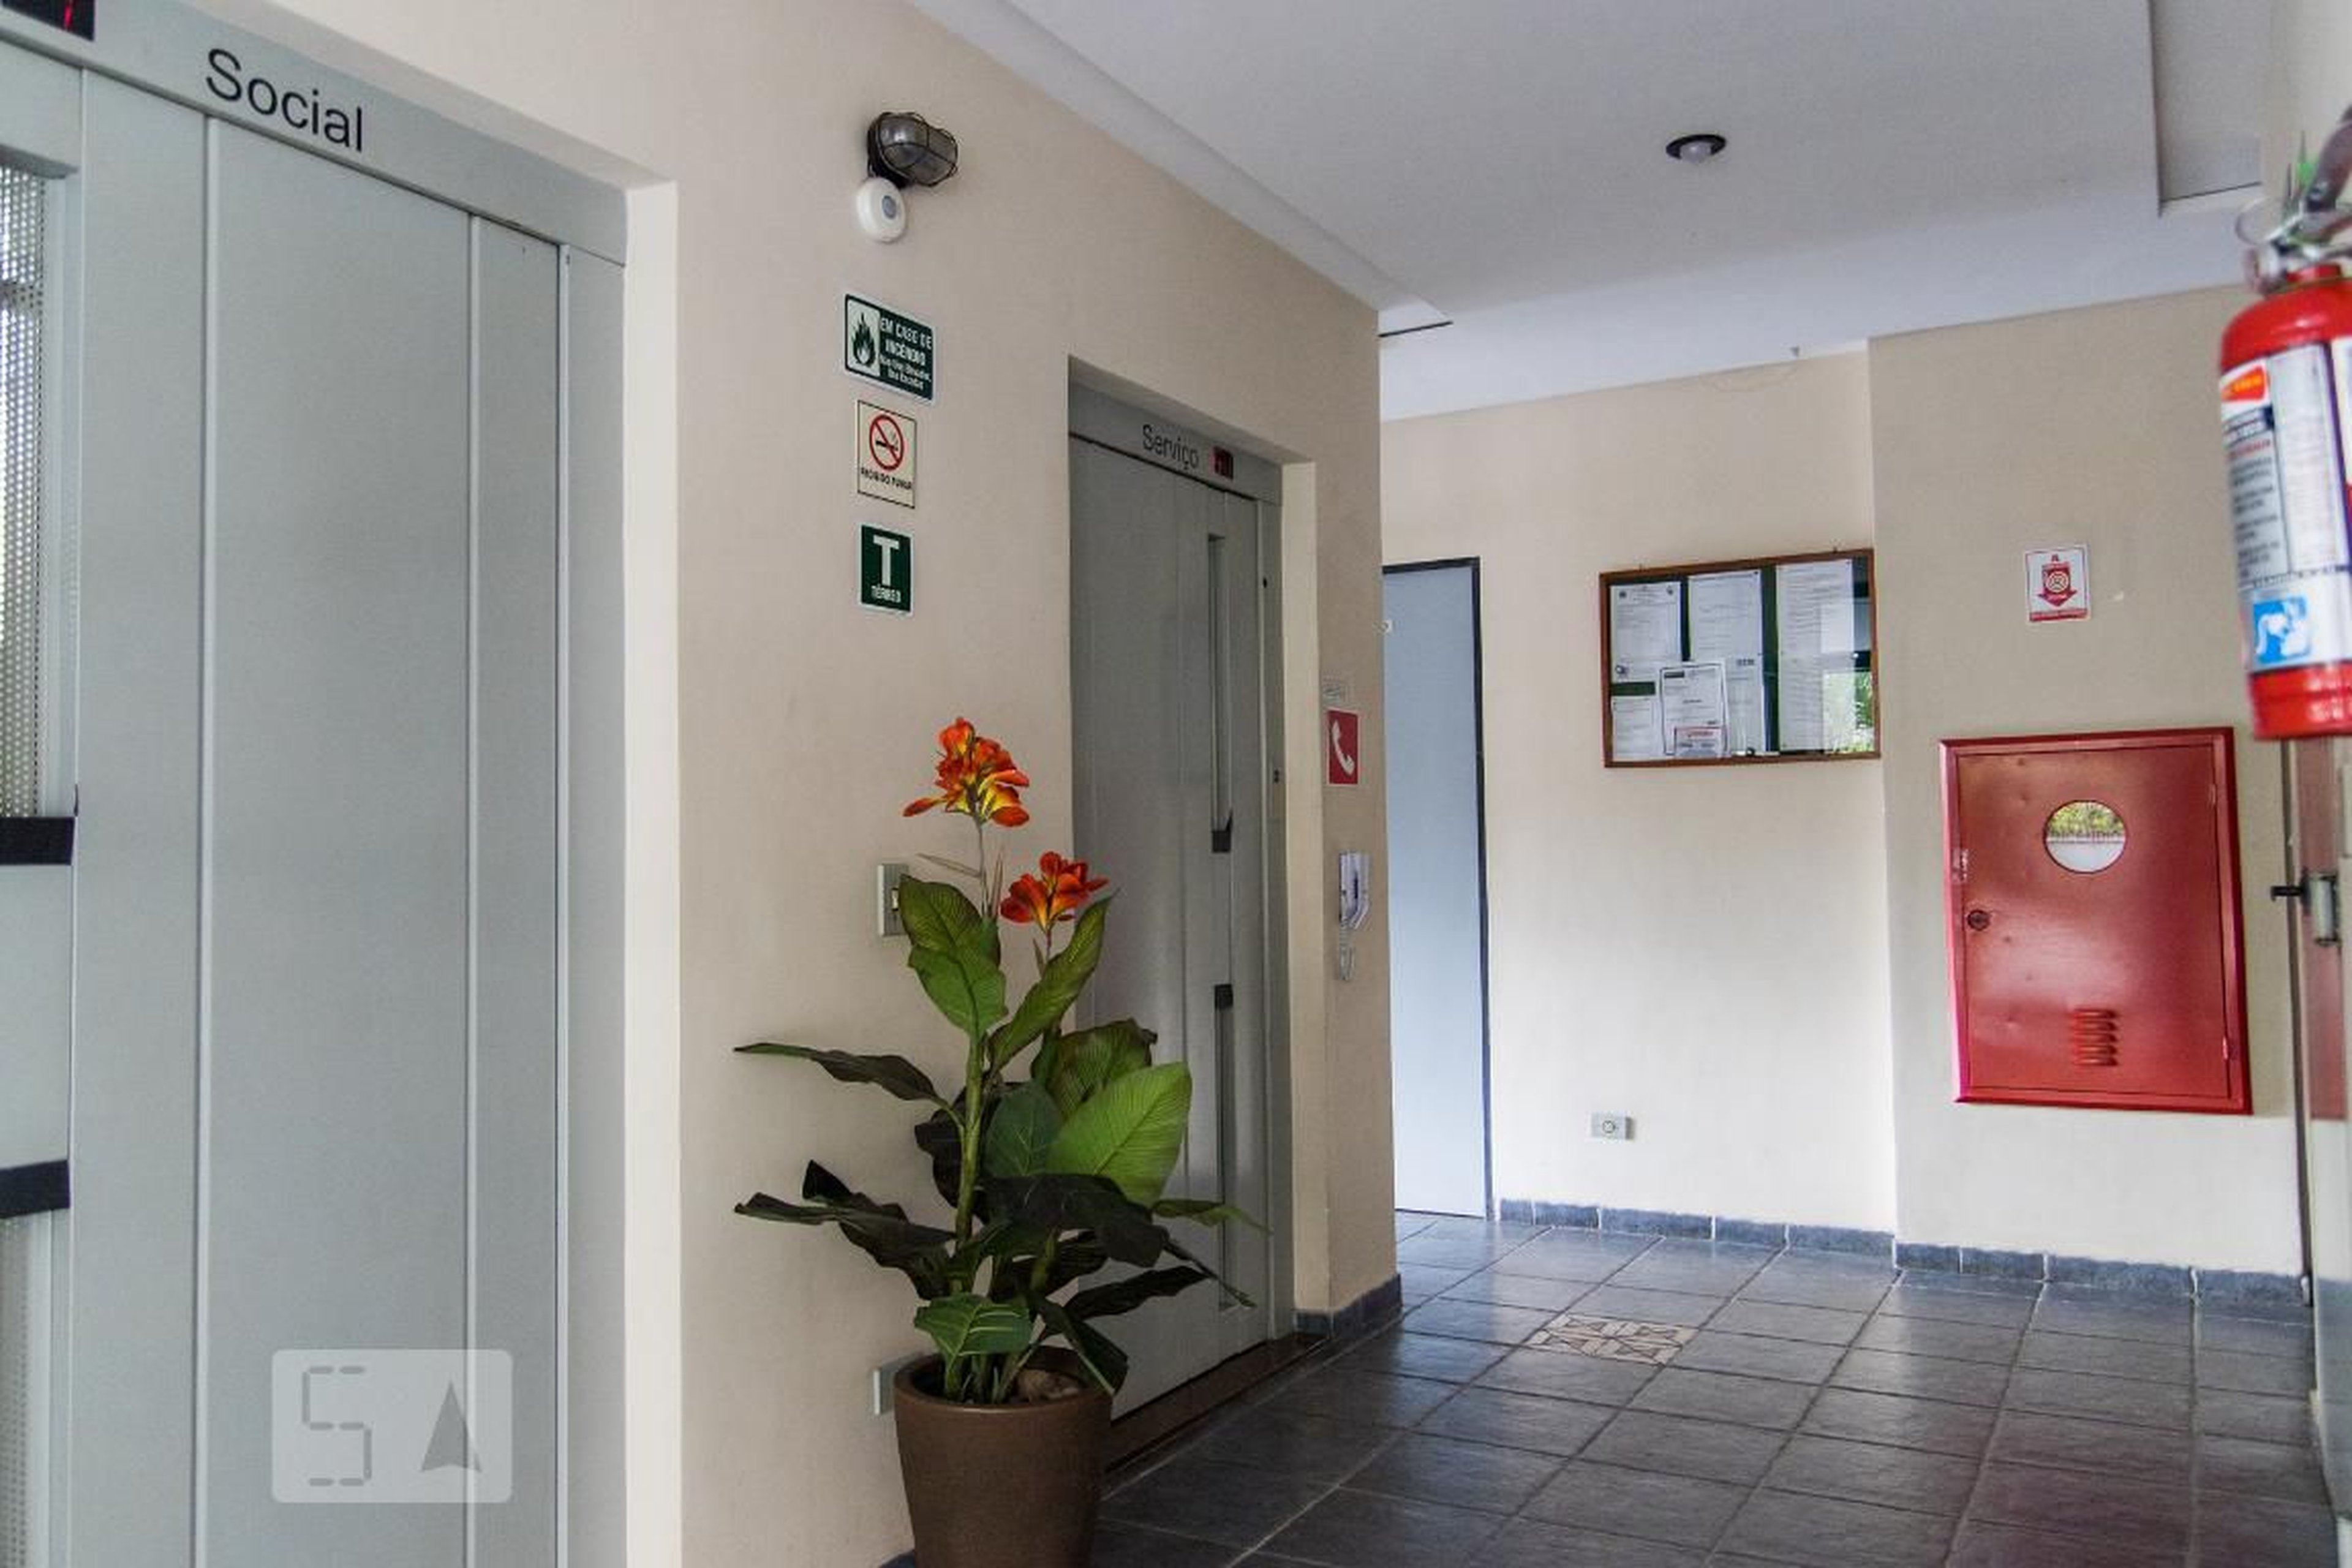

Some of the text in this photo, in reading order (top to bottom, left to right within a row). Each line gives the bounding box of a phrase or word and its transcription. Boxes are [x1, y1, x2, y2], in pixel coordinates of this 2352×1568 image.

[206, 48, 363, 153] Social
[1142, 424, 1200, 471] Serviço
[873, 535, 900, 587] T
